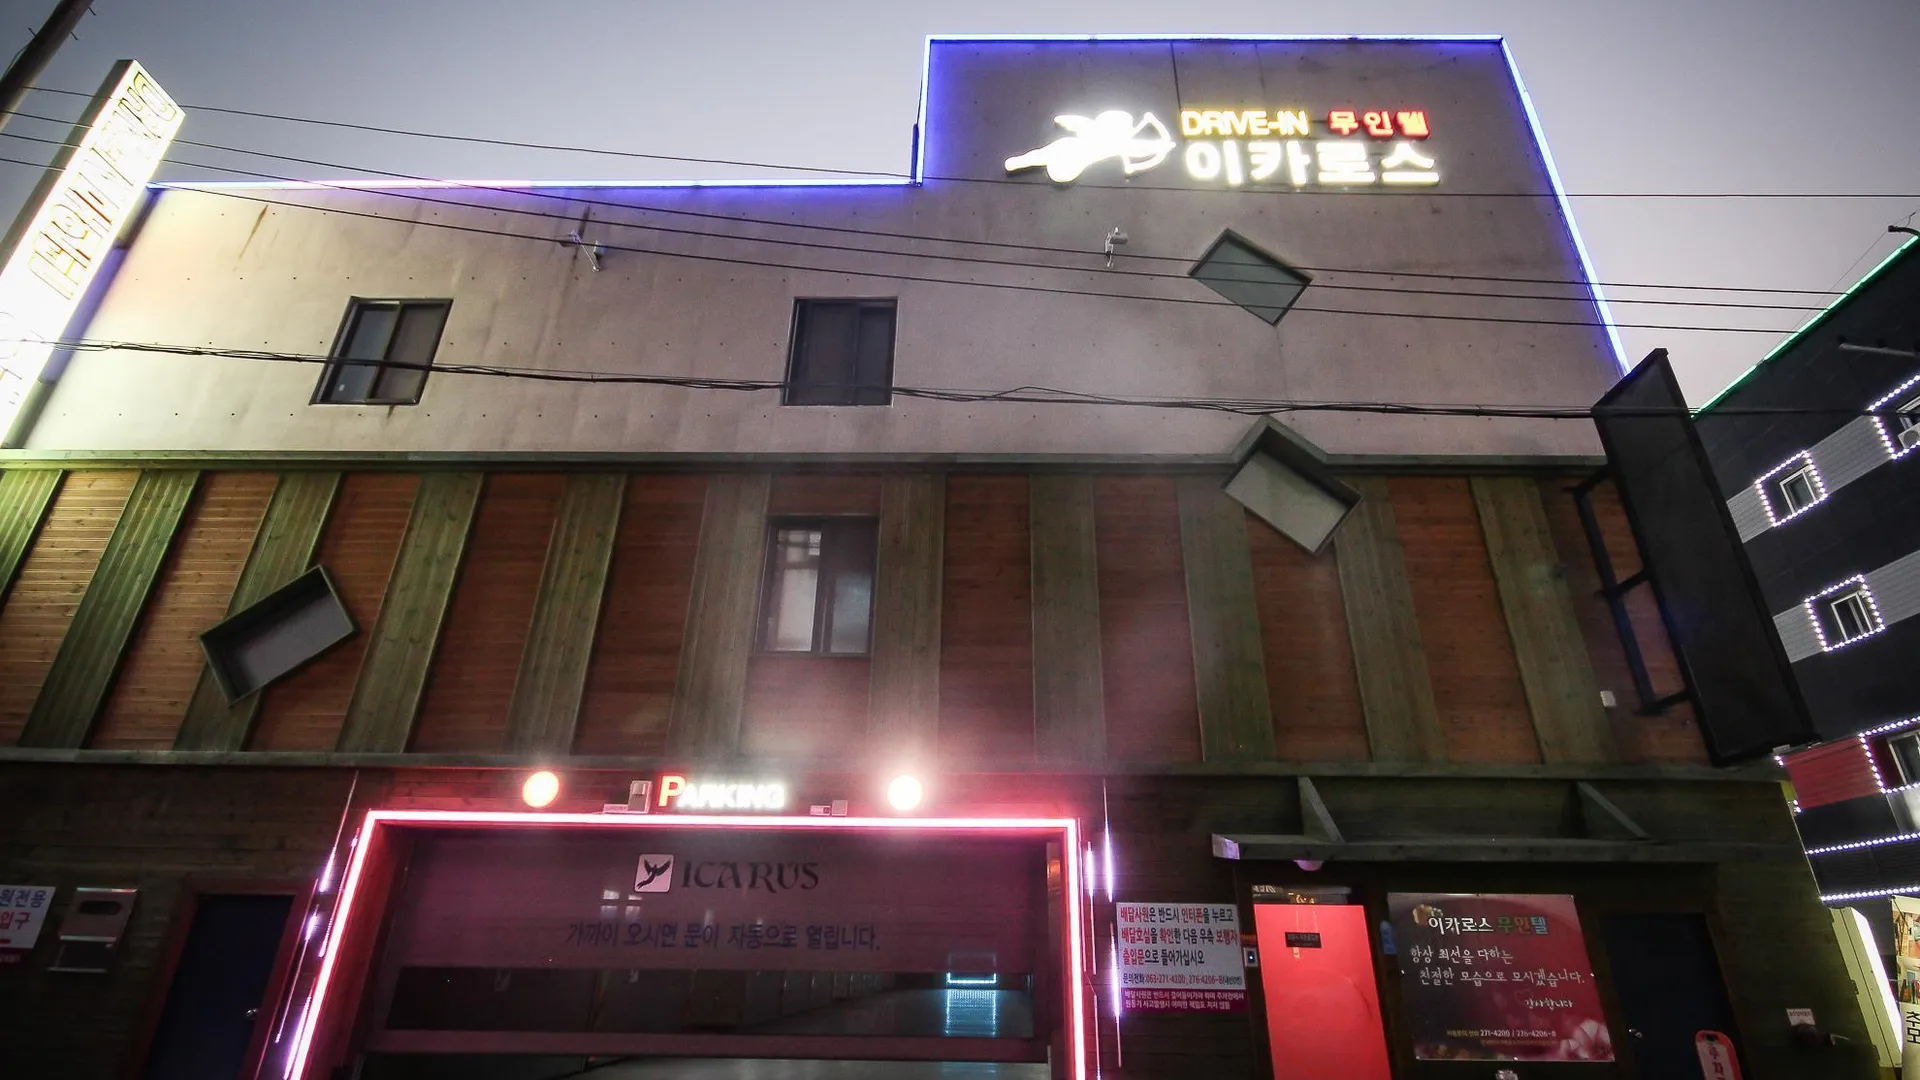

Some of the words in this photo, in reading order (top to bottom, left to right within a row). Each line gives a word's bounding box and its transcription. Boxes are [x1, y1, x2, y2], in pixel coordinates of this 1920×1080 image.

[1180, 110, 1309, 137] DRIVE-IN
[657, 774, 785, 809] PARKING
[681, 861, 820, 893] ICARUS
[1120, 907, 1157, 923] 배달사원은
[1158, 907, 1180, 923] 반드시
[1181, 907, 1210, 924] 인터폰을
[1212, 908, 1234, 923] 누르고
[1428, 916, 1494, 935] 이카로스
[1497, 916, 1548, 935] 무인텔
[566, 922, 618, 948] 가까이
[623, 923, 678, 948] 오시면
[684, 923, 719, 948] 문이
[727, 923, 798, 949] 자동으로
[1121, 927, 1158, 944] 배달호실을
[1160, 928, 1181, 944] 확인한
[1183, 929, 1198, 945] 다음
[1123, 948, 1159, 966] 출입문으로
[1161, 949, 1205, 966] 들어가십시오
[1410, 945, 1434, 964] 항상
[1438, 945, 1475, 965] 최선을
[1477, 946, 1514, 965] 다하는
[1419, 967, 1455, 986] 친절한
[1460, 970, 1508, 987] 모습으로
[1512, 968, 1586, 987] 모시겠습니다.
